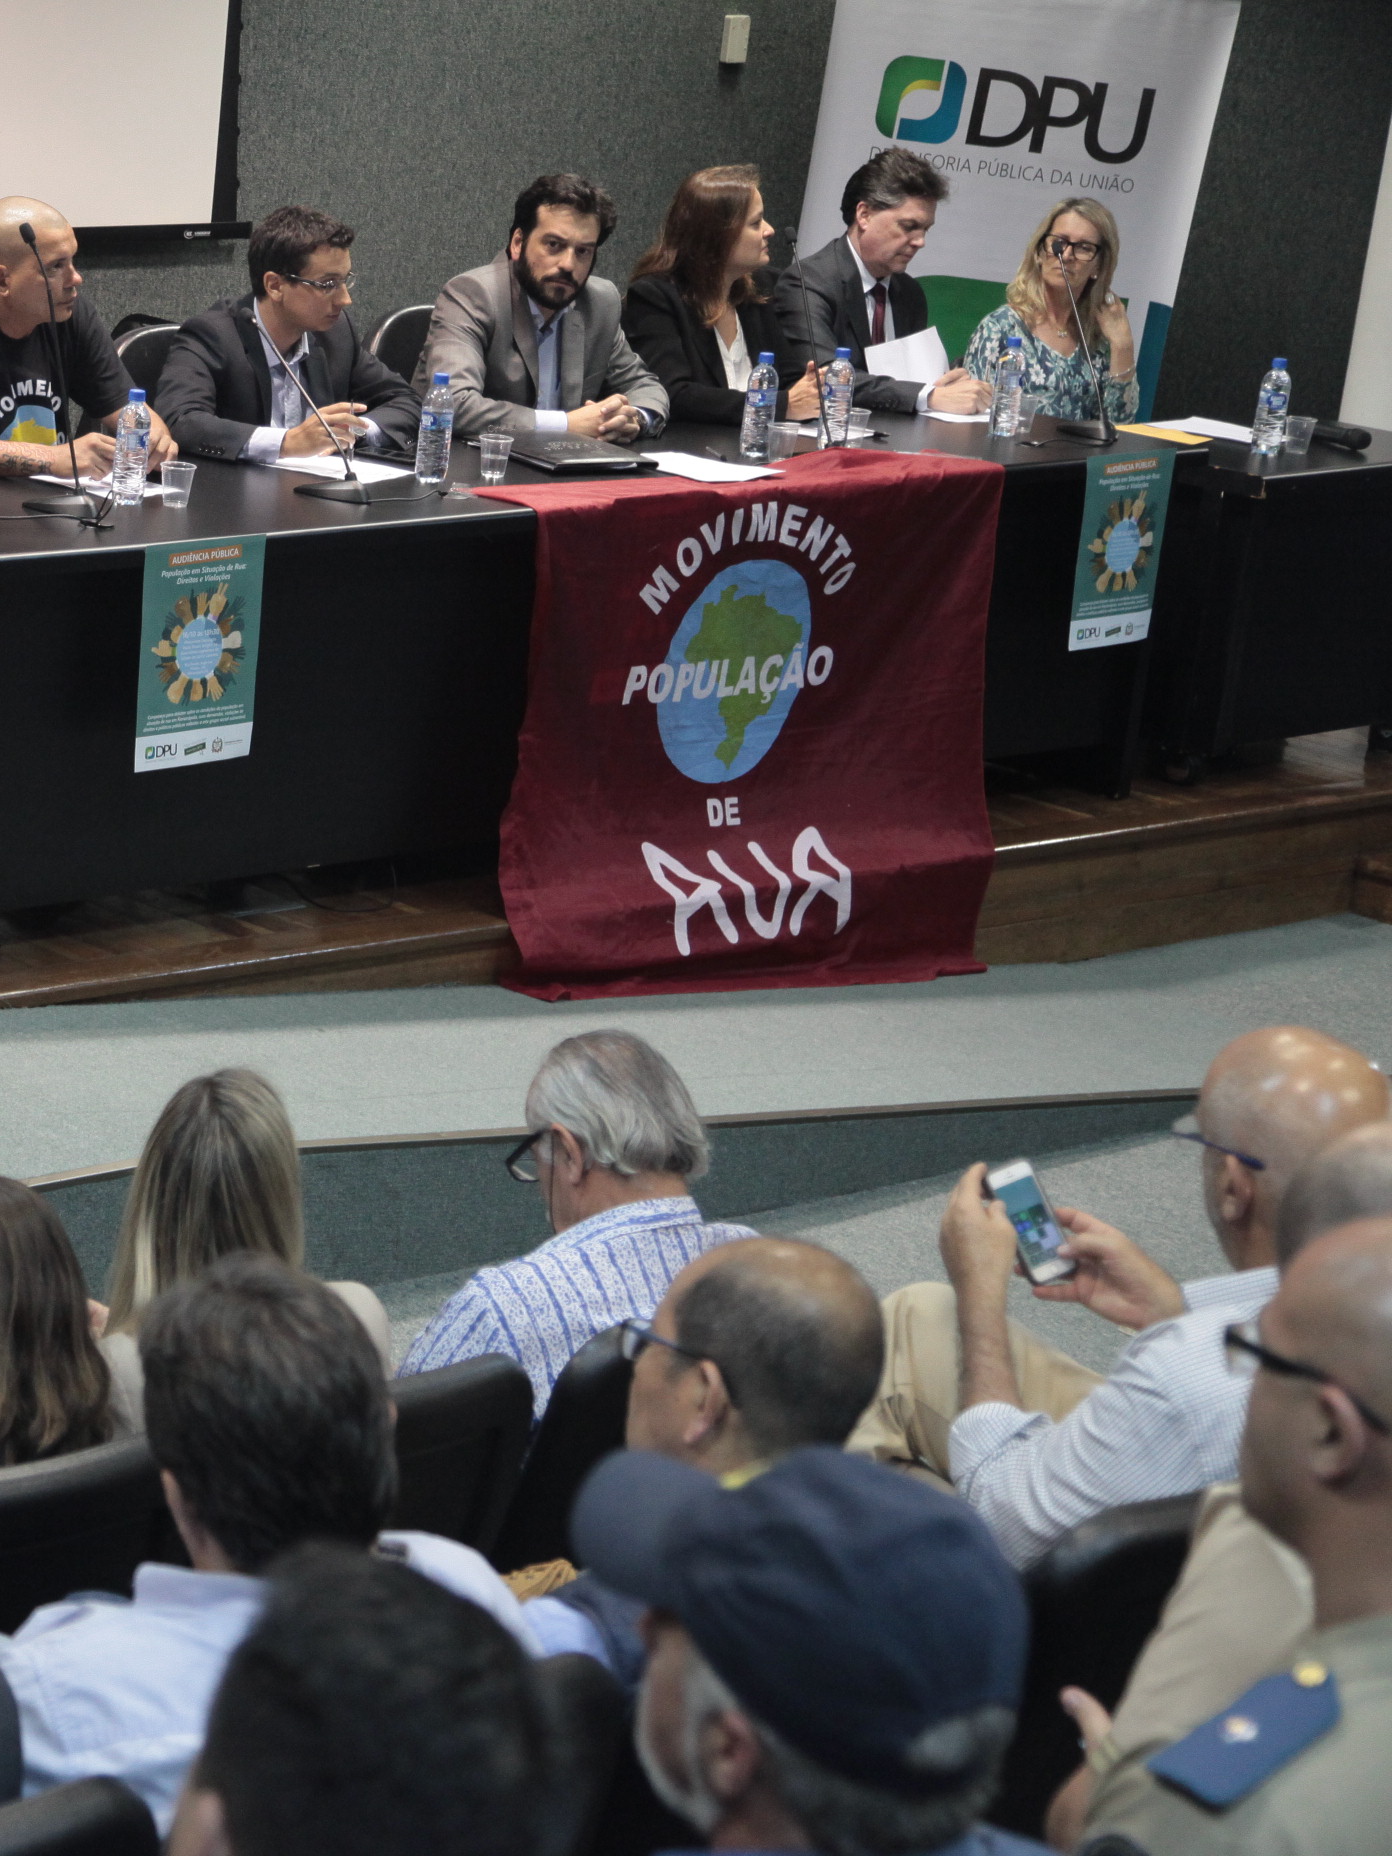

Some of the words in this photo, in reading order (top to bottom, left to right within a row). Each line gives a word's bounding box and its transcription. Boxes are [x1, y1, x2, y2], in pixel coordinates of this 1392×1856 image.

[965, 67, 1156, 164] DPU
[977, 158, 1044, 183] PÚBLICA
[1050, 169, 1073, 186] DA
[1079, 173, 1135, 193] UNIÃO
[161, 569, 190, 579] População
[202, 565, 226, 574] Situação
[227, 563, 234, 571] de
[172, 553, 210, 565] AUDIÊNCIA
[211, 548, 240, 559] PÚBLICA
[639, 500, 857, 615] MOVIMENTO
[177, 577, 199, 585] Direitos
[205, 574, 231, 582] Violações
[621, 643, 834, 705] POPULAÇÃO
[156, 743, 177, 757] DPU
[707, 796, 741, 827] DE
[641, 826, 852, 957] RUA
